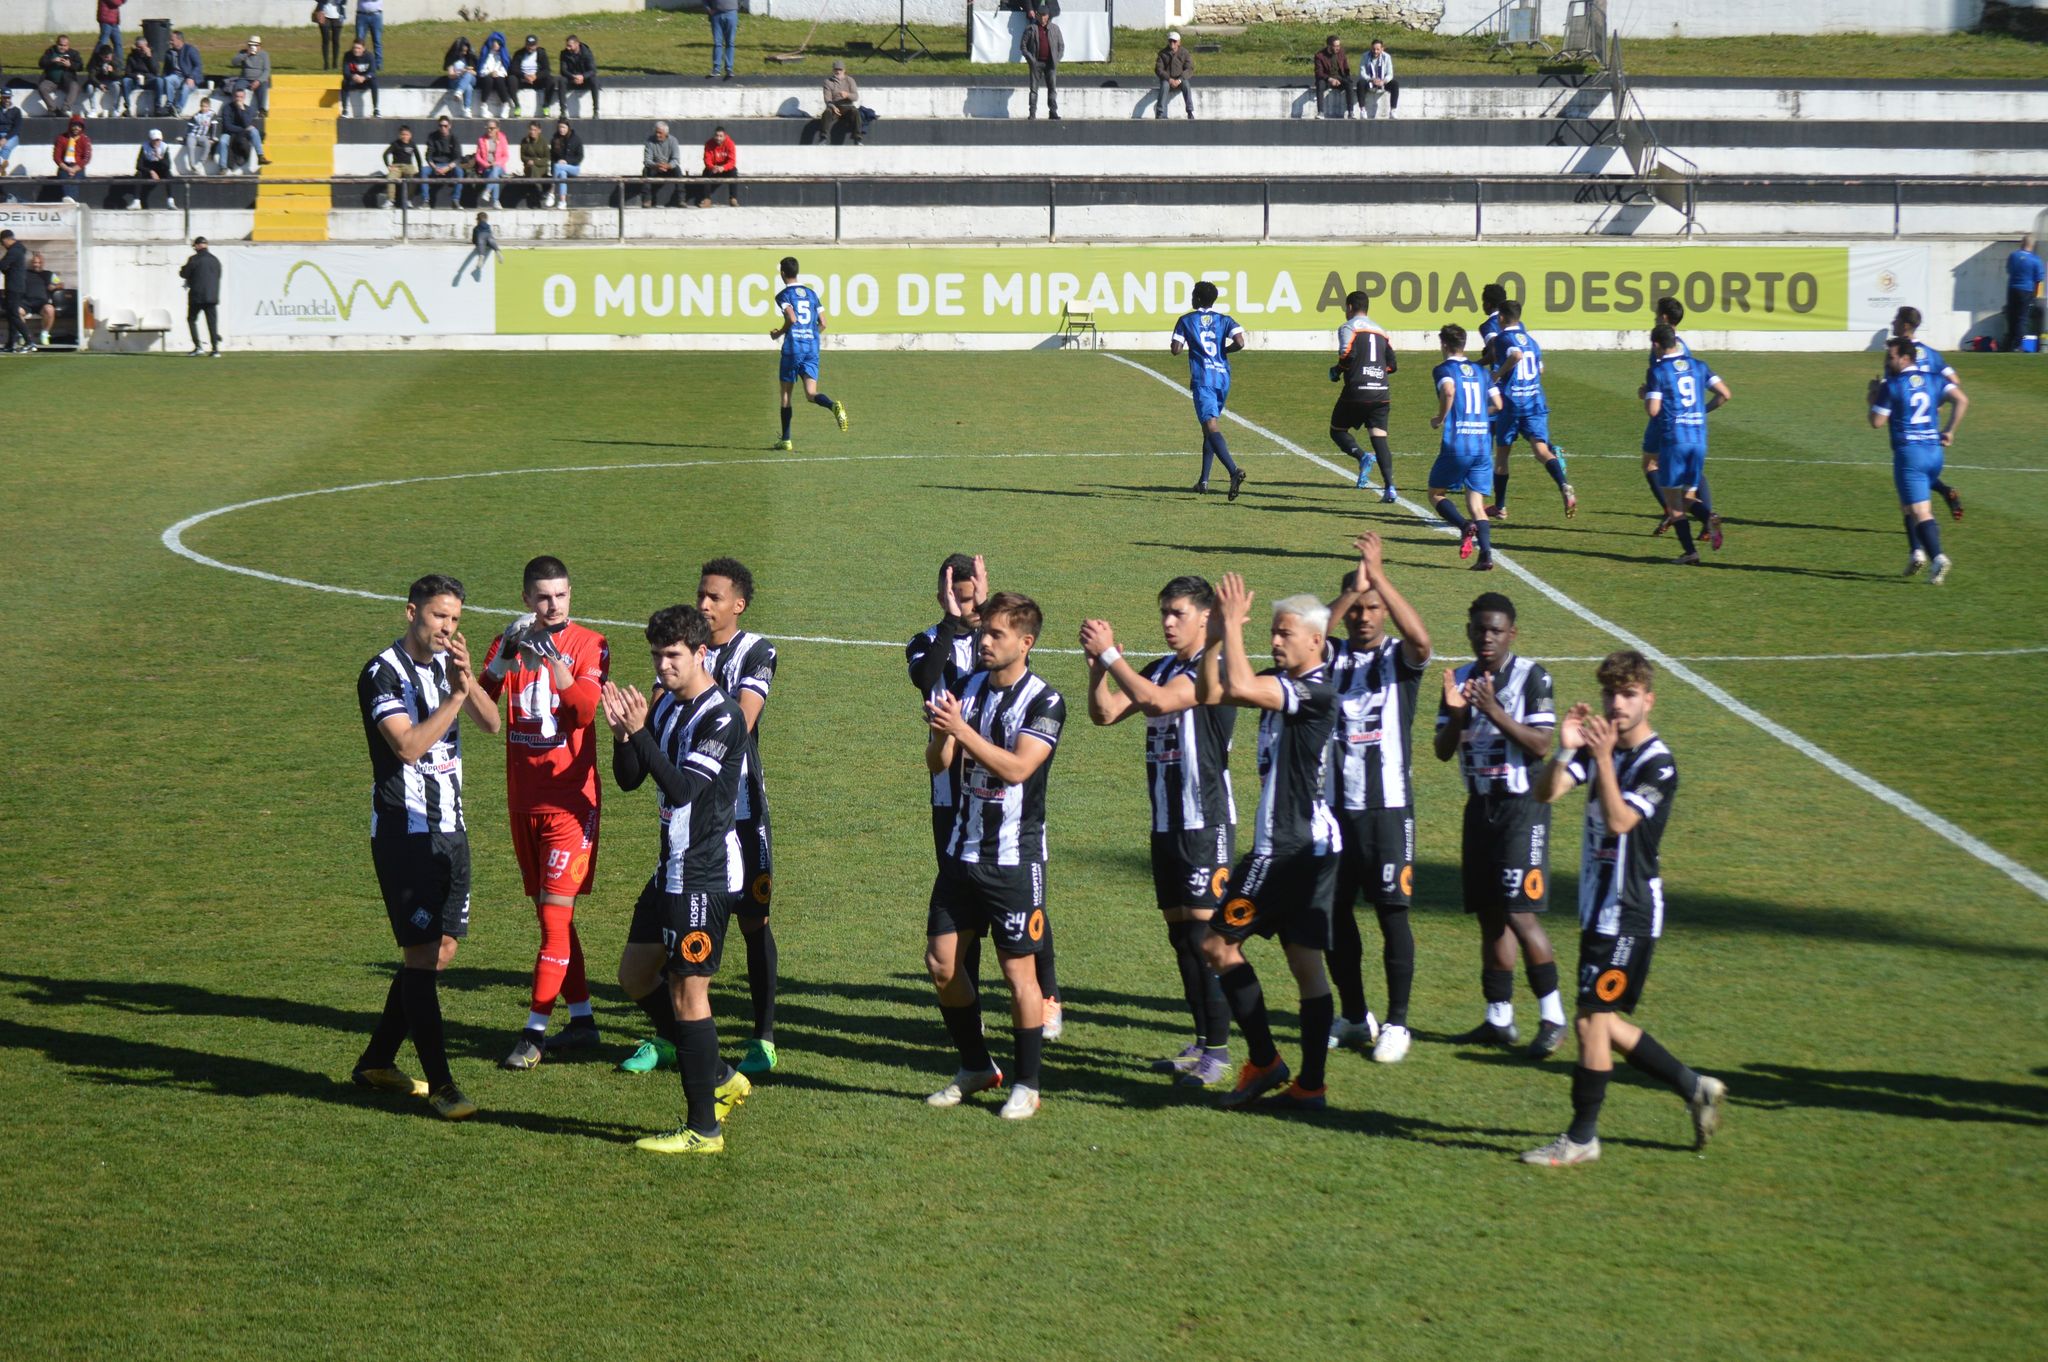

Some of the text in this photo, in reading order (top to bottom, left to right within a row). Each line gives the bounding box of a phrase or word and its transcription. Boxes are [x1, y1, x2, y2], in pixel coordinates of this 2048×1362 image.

[254, 299, 336, 316] Mirandela
[543, 273, 577, 317] O
[897, 273, 966, 316] DE
[983, 270, 1302, 316] MIRANDELA
[1315, 270, 1479, 313] APOIA
[1545, 271, 1818, 314] DESPORTO
[797, 300, 812, 325] 5
[1199, 331, 1218, 358] 6
[1368, 333, 1377, 362] 1
[1516, 350, 1538, 380] 10
[1462, 381, 1482, 415] 11
[1677, 375, 1696, 408] 9
[1909, 392, 1932, 425] 2
[1004, 911, 1027, 932] 24
